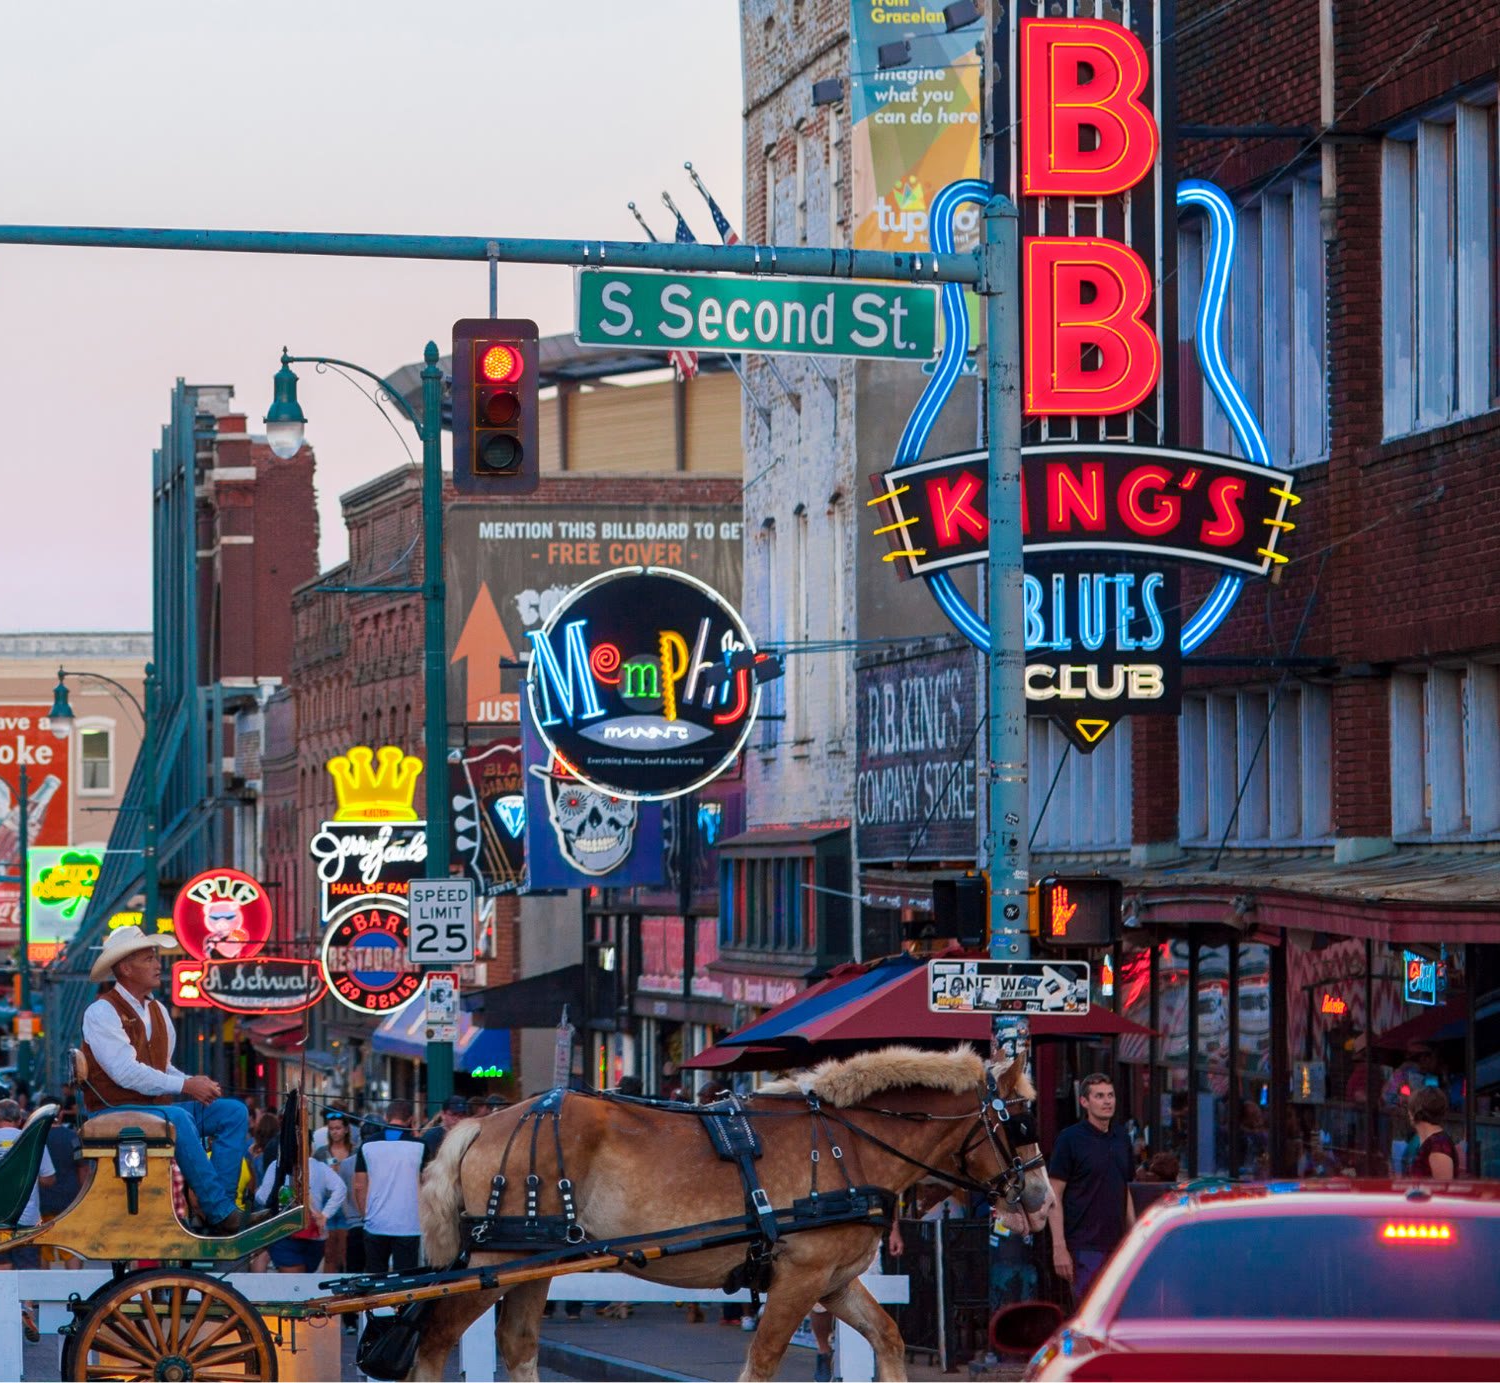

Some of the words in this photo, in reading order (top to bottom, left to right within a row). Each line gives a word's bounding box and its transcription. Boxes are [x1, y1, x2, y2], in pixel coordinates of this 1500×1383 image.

[873, 65, 946, 86] imagine
[874, 85, 918, 102] what
[923, 91, 954, 107] you
[1020, 17, 1159, 197] B
[874, 111, 906, 124] can
[910, 107, 933, 124] do
[937, 107, 979, 124] here
[874, 196, 977, 243] tupo
[599, 281, 642, 337] S.
[658, 284, 834, 345] Second
[849, 293, 916, 350] St.
[1023, 236, 1162, 417] B
[479, 522, 553, 540] MENTION
[558, 522, 596, 539] THIS
[602, 522, 689, 540] BILLBOARD
[694, 523, 714, 540] TO
[548, 543, 600, 565] FREE
[608, 543, 683, 566] COVER
[1023, 572, 1165, 652] BLUES
[1024, 664, 1165, 700] CLUB
[38, 717, 51, 731] a
[857, 764, 921, 825] COMPANY
[923, 760, 975, 820] STORE
[187, 876, 259, 905] PIG
[331, 884, 364, 894] HALL
[366, 883, 384, 894] OF
[414, 889, 468, 902] SPEED
[352, 910, 400, 933] BAR
[421, 906, 462, 919] LIMIT
[416, 924, 468, 953] 25
[336, 976, 361, 1001] 159
[366, 975, 419, 1008] BEALE
